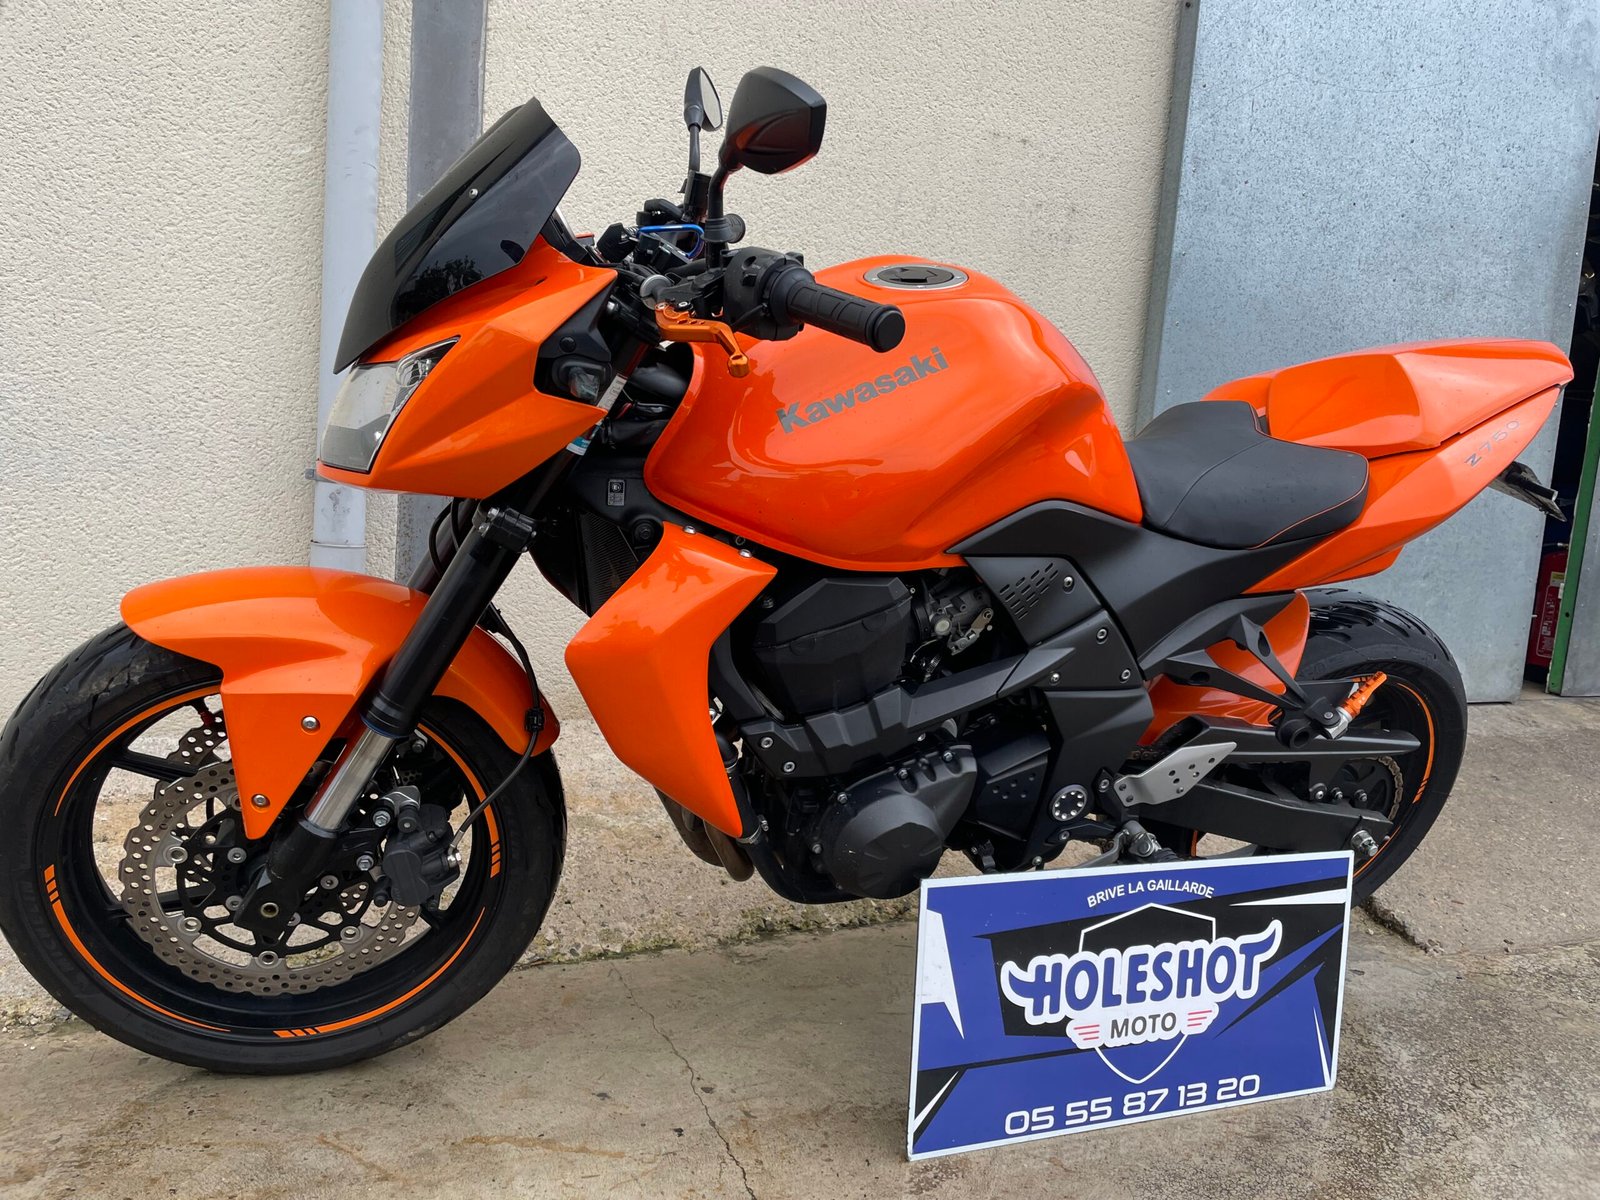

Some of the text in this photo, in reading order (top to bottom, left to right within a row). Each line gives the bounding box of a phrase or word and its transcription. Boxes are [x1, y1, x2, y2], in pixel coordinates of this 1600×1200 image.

[775, 346, 949, 434] Kawasaki
[1464, 420, 1519, 467] Z750
[1087, 879, 1214, 908] BRIVE LA GAILLARDE
[1002, 923, 1279, 1018] HOLESHOT
[1110, 1012, 1176, 1040] MOTO
[1004, 1074, 1261, 1135] 05 55 87 13 20
